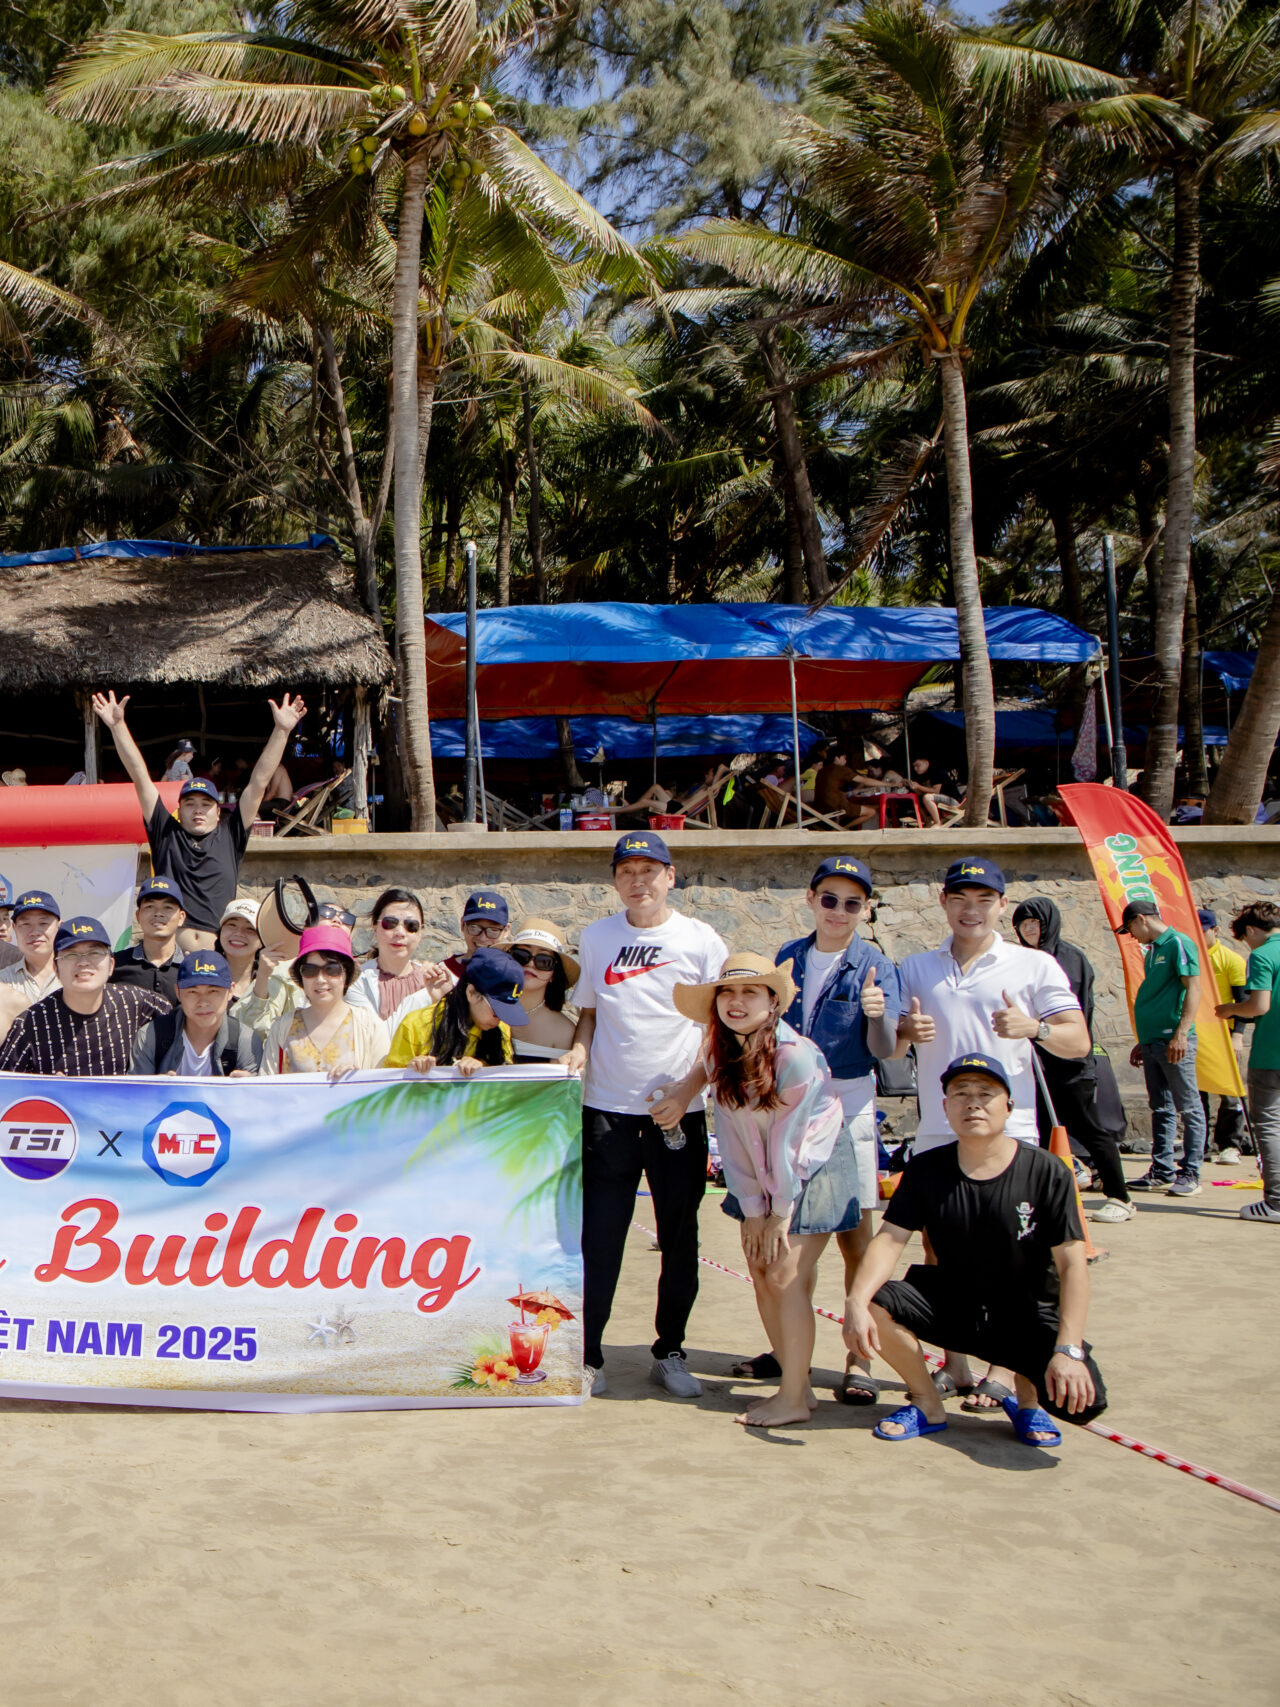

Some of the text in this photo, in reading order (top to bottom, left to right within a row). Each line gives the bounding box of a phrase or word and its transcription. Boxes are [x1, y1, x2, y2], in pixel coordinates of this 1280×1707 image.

[1104, 832, 1160, 908] DING
[613, 946, 663, 968] NIKE
[157, 1133, 216, 1155] MTC
[34, 1198, 481, 1313] Building
[46, 1319, 143, 1357] NAM
[156, 1324, 258, 1362] 2025
